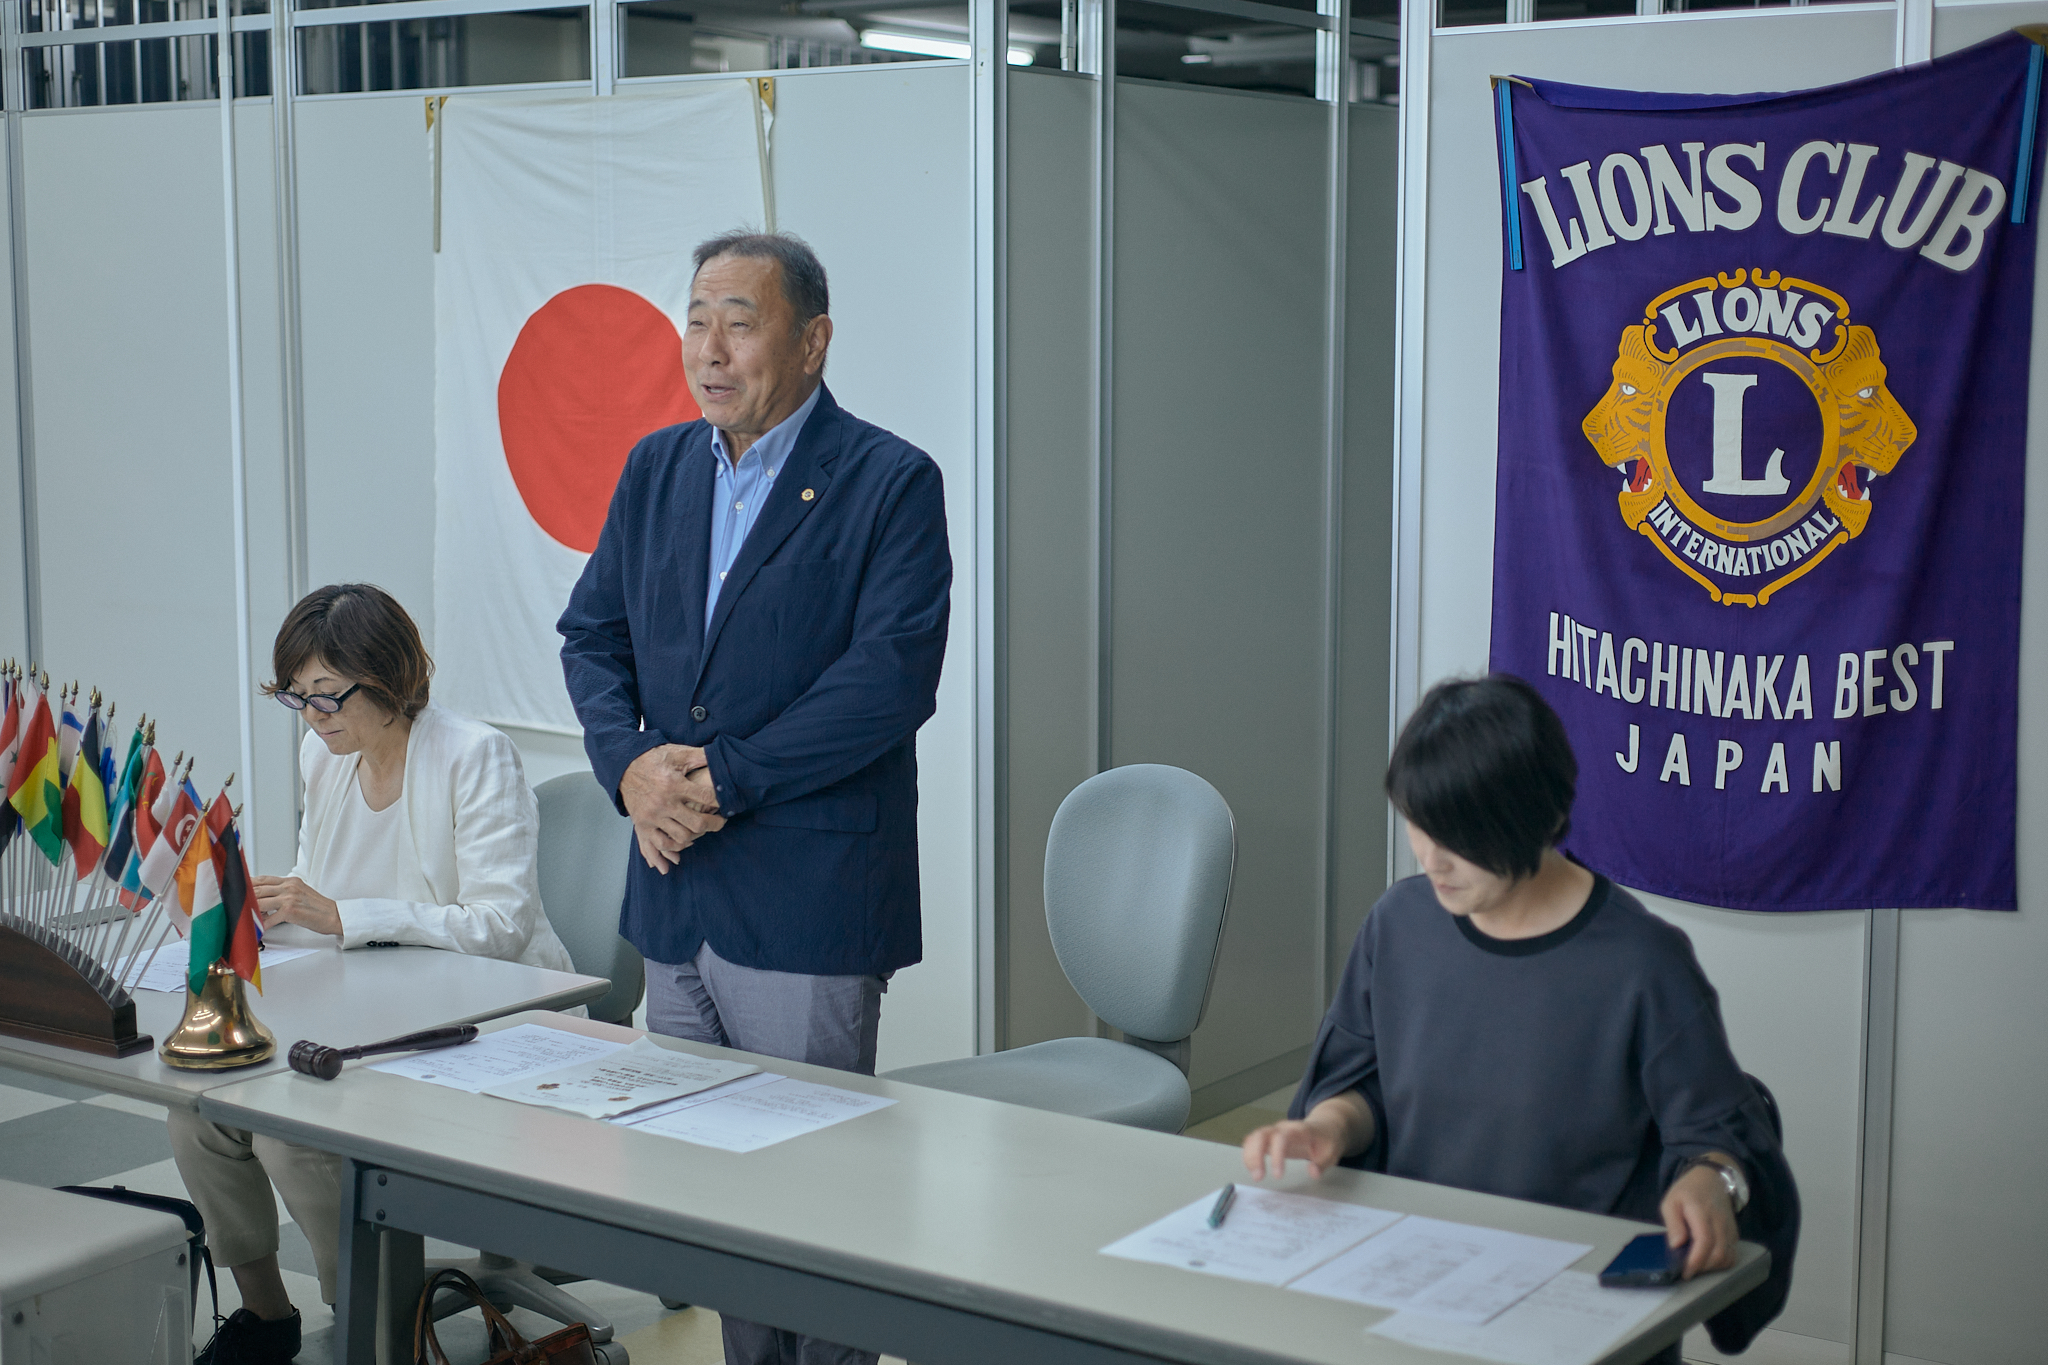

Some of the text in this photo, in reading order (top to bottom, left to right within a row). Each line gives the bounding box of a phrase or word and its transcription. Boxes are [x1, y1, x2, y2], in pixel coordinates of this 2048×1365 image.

[1520, 140, 2008, 272] LIONS CLUB
[1659, 286, 1835, 350] LIONS
[1702, 372, 1791, 496] L
[1648, 499, 1840, 577] INTERNATIONAL
[1547, 610, 1956, 721] HITACHINAKA BEST
[1615, 723, 1842, 794] JAPAN
